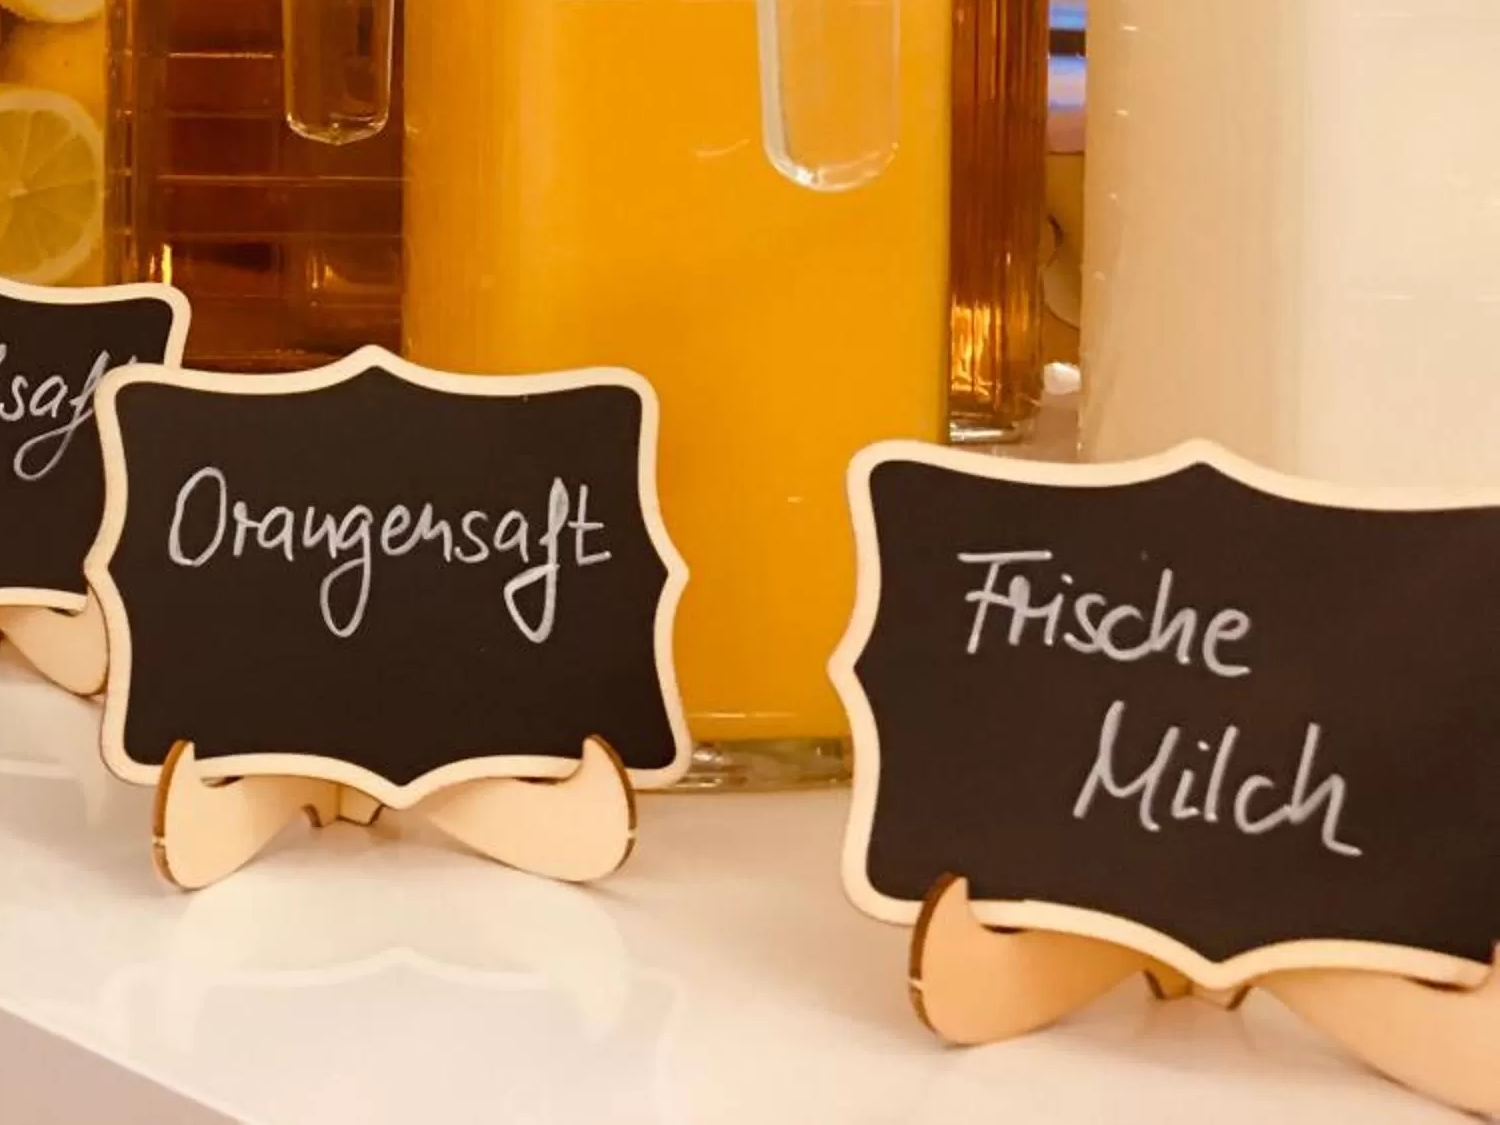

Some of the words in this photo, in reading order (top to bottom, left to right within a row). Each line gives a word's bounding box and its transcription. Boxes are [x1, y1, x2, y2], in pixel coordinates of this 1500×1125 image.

[168, 466, 612, 644] Orangensaft
[957, 550, 1251, 677] Frische
[1072, 700, 1362, 857] Milch
